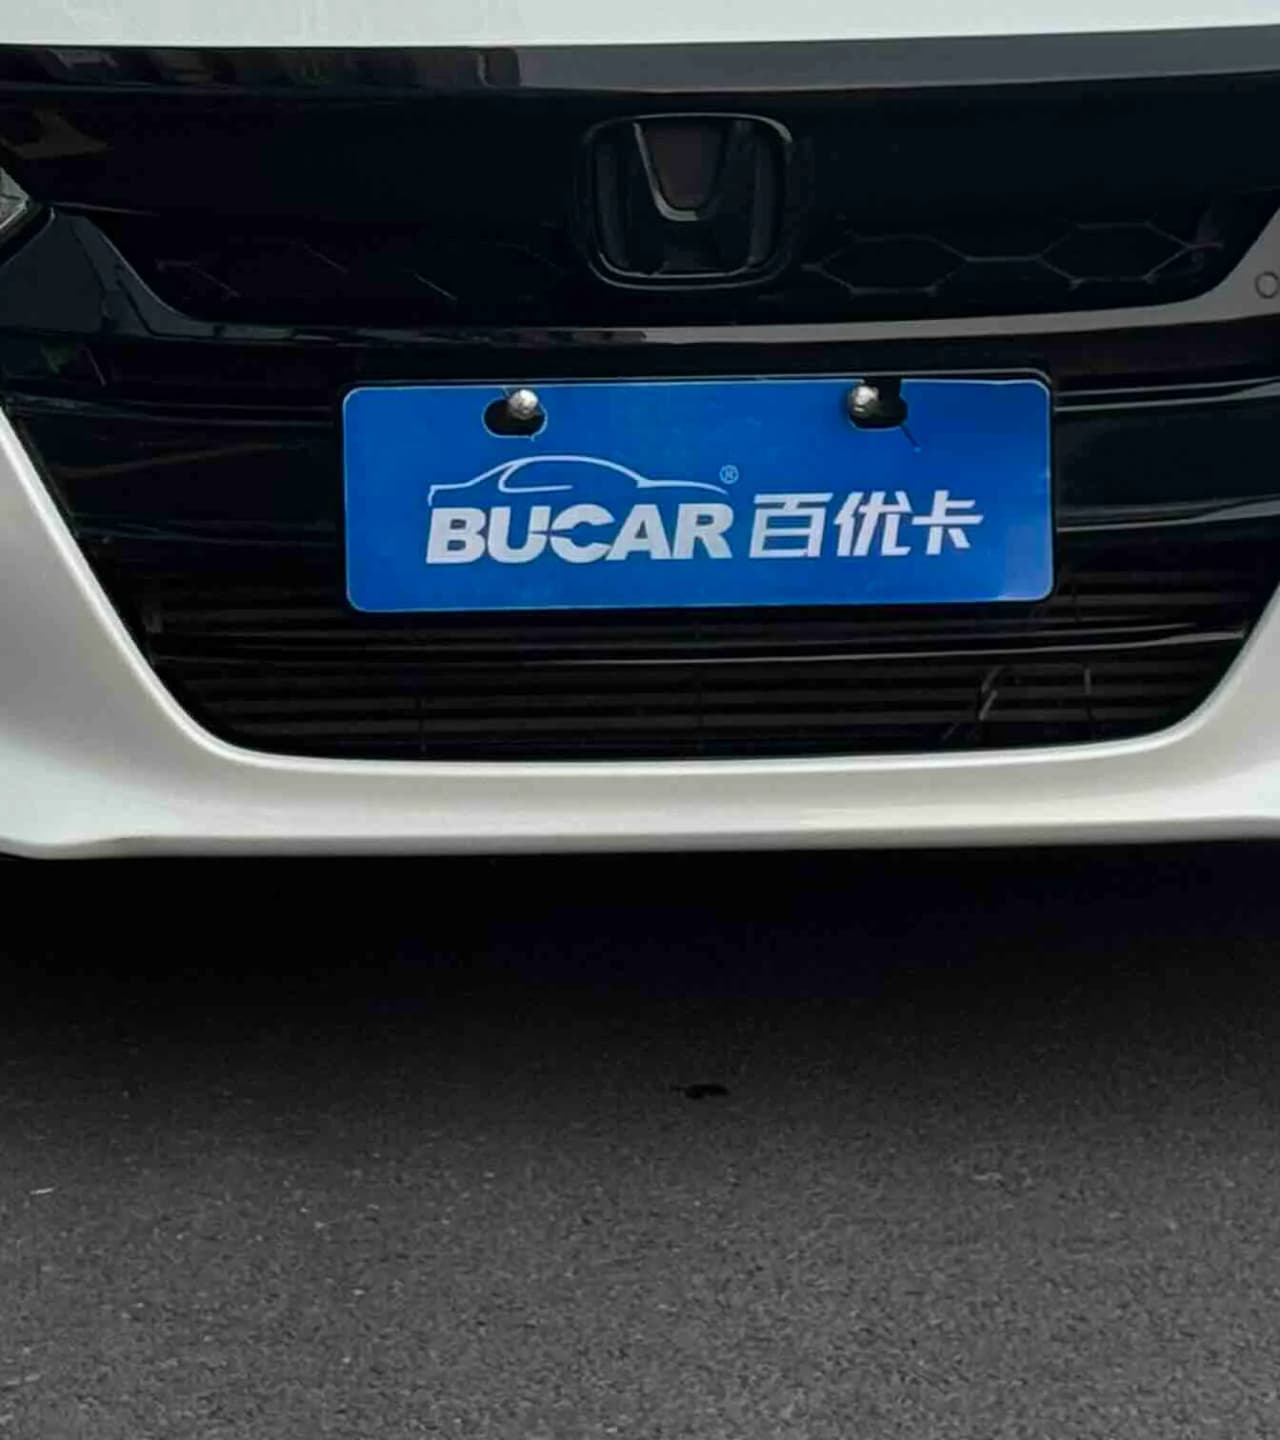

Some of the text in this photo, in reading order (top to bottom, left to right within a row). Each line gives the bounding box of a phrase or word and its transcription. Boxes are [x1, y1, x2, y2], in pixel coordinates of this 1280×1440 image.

[426, 489, 985, 564] BUCAR 百优卡
